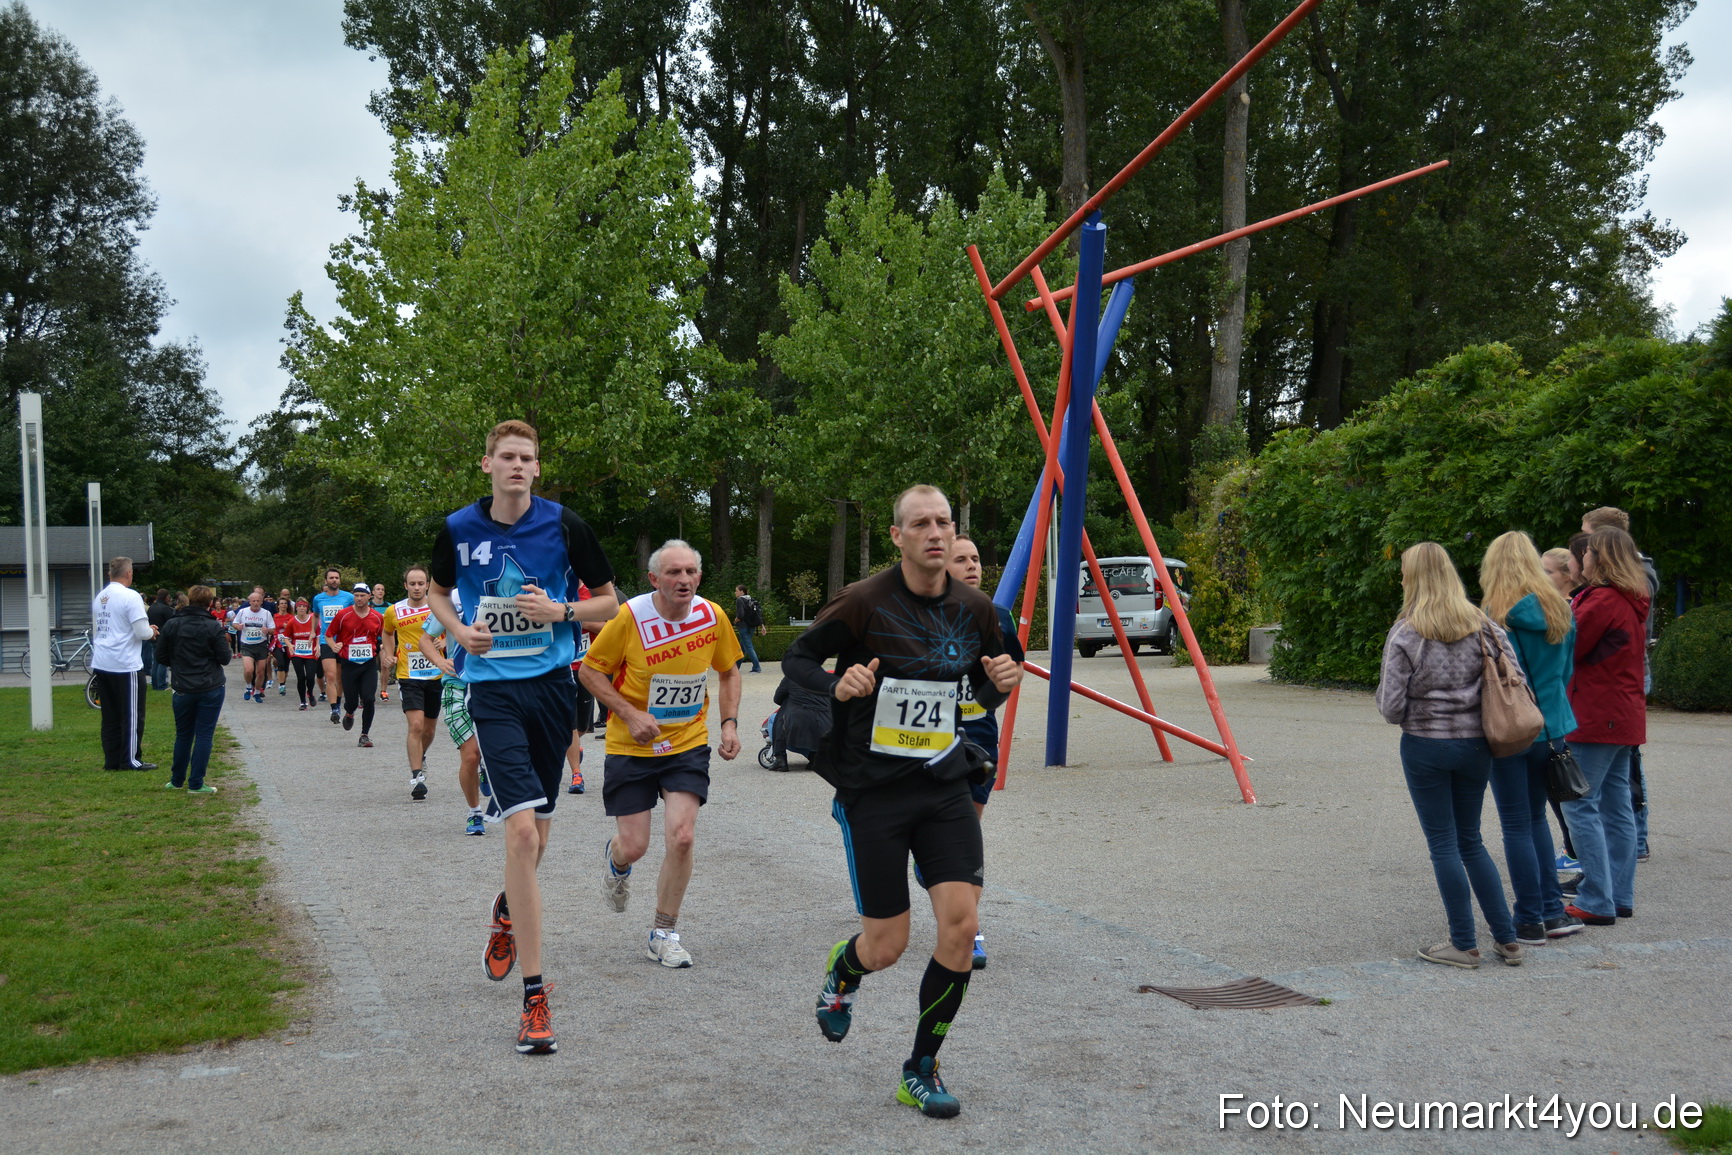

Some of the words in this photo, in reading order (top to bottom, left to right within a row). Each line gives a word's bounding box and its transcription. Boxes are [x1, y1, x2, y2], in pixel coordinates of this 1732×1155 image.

[456, 541, 493, 567] 14
[480, 602, 502, 610] PARTL
[398, 617, 419, 628] MAX
[491, 636, 543, 650] Maximilian
[645, 645, 684, 667] MAX
[686, 632, 718, 653] BÖGL
[351, 648, 372, 658] 2043
[411, 658, 438, 670] 282
[652, 677, 673, 685] PARTL
[673, 677, 701, 685] Neumarkt
[655, 684, 703, 705] 2737
[881, 685, 910, 696] PARTL
[911, 688, 947, 698] Neumarkt
[663, 708, 690, 718] Johann
[896, 699, 942, 728] 124
[897, 733, 931, 748] Stefan
